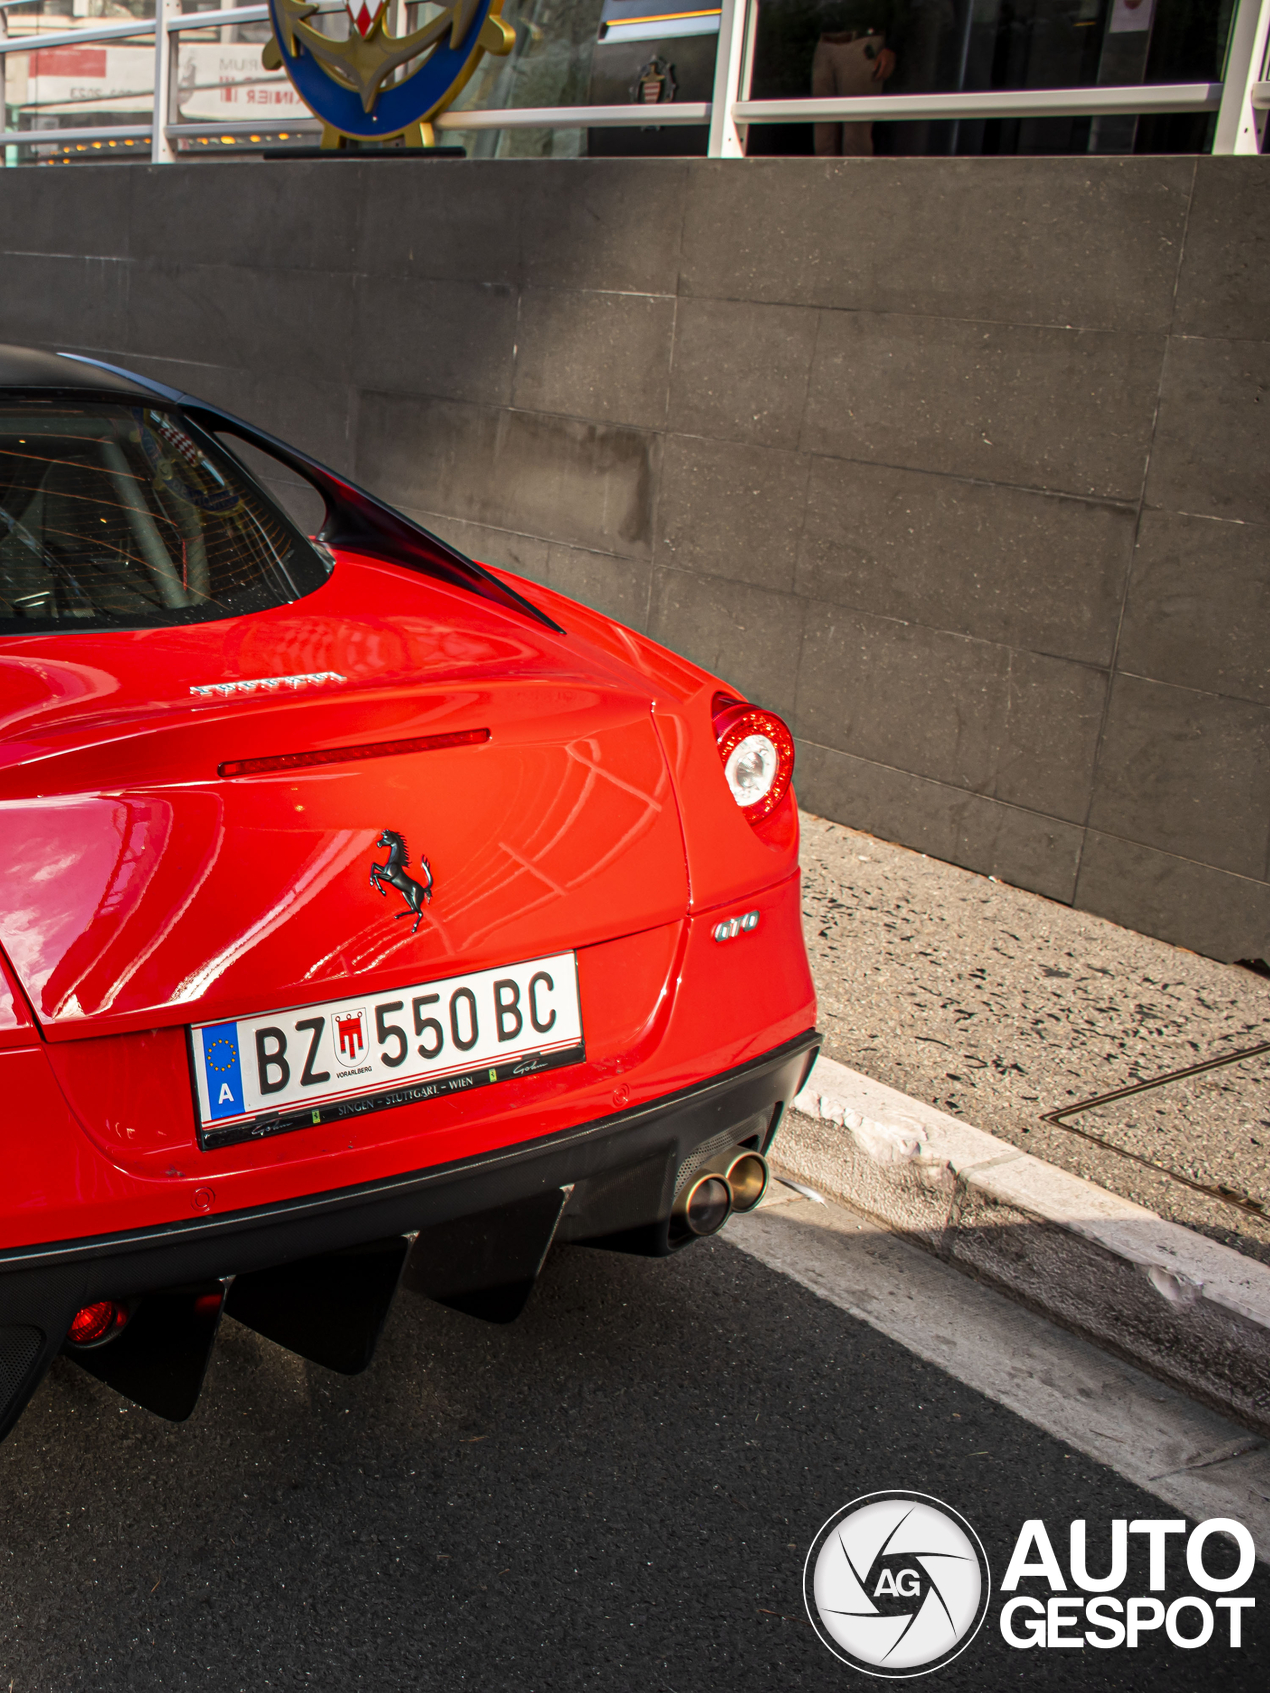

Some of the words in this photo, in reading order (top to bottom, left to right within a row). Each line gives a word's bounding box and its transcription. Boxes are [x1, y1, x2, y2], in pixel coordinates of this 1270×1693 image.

[255, 1016, 331, 1096] BZ
[375, 986, 480, 1068] 550
[493, 971, 556, 1044] BC
[336, 1065, 373, 1079] VORARLBERG
[218, 1083, 235, 1105] A
[338, 1099, 375, 1116] SINGEN
[385, 1084, 438, 1105] STUTTGART
[448, 1076, 474, 1090] WIEN
